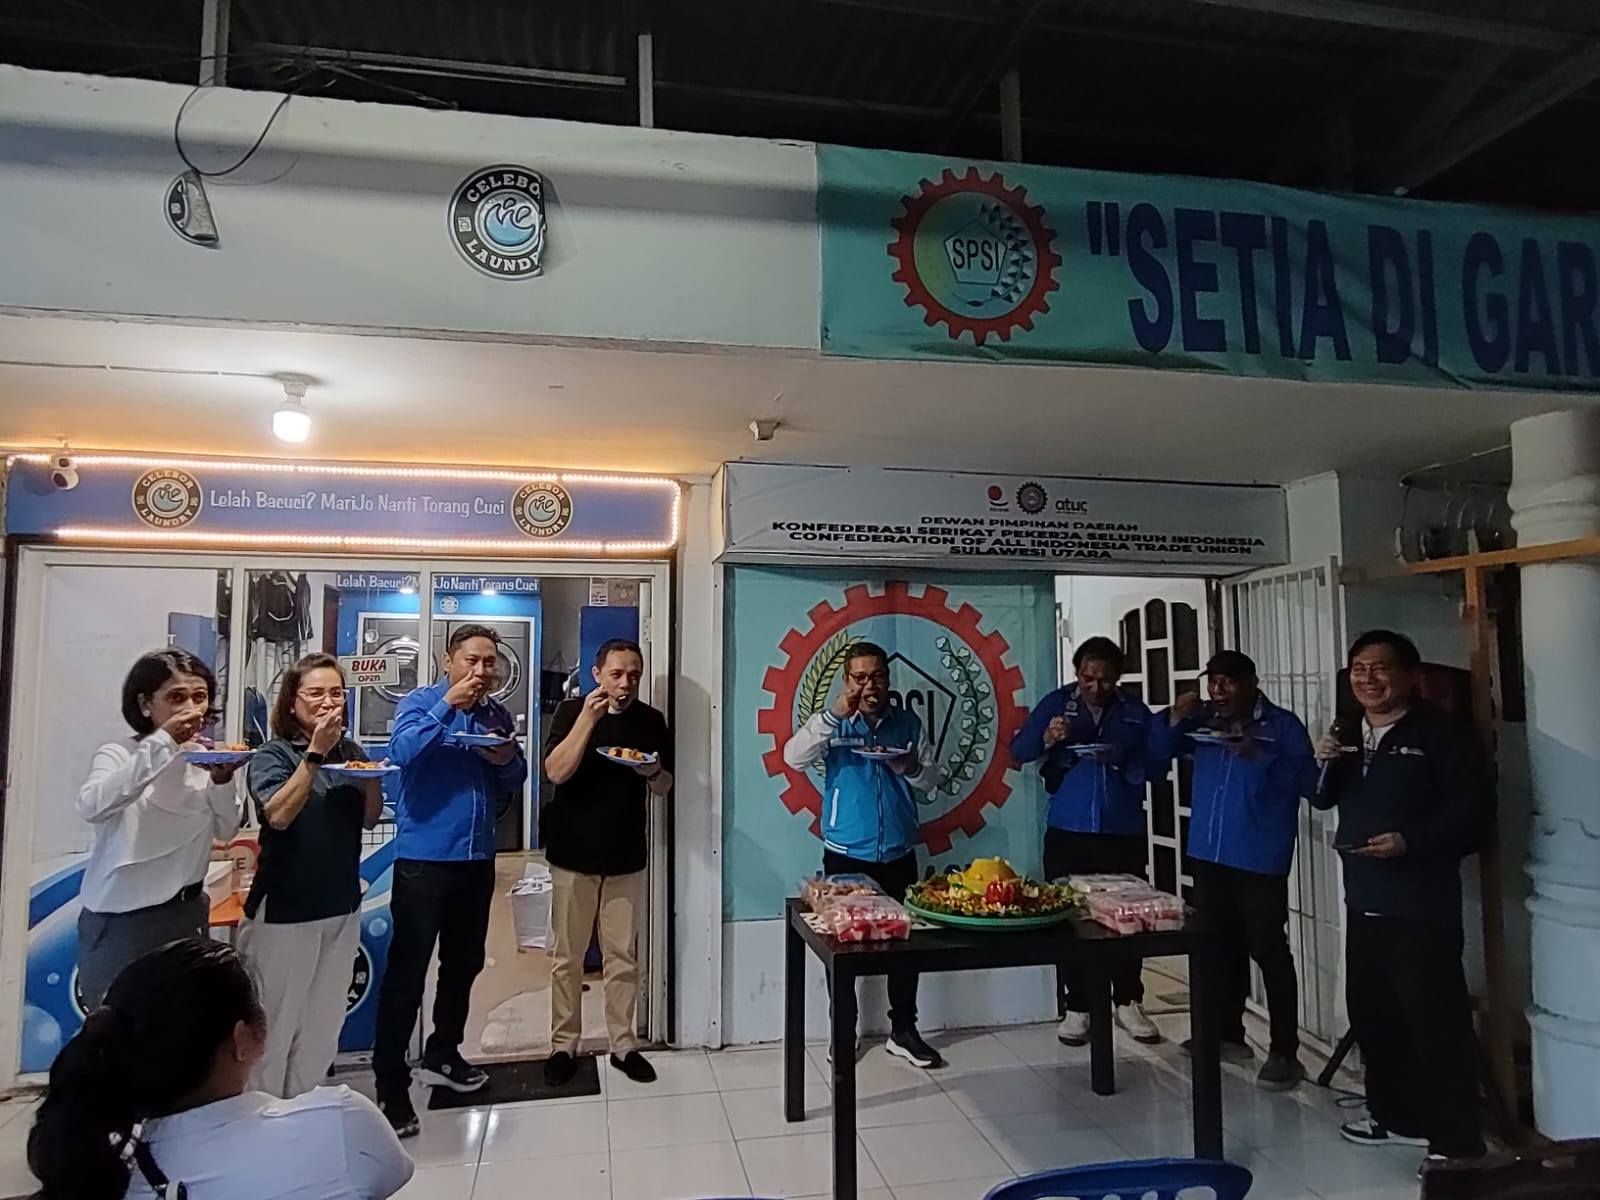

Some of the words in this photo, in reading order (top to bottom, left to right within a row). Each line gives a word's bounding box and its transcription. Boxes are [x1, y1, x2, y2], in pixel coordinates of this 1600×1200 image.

[466, 174, 541, 202] CELEBO
[952, 238, 999, 272] SPSI
[1086, 200, 1352, 362] "SETIA
[1368, 224, 1439, 367] DI
[142, 470, 194, 489] CELEBOR
[519, 483, 566, 501] CELEBOR
[210, 489, 250, 508] Lelah
[256, 491, 316, 510] Bacuci?
[378, 495, 417, 512] Nanti
[422, 497, 470, 518] Torang
[474, 497, 505, 515] Cuci
[1055, 498, 1088, 512] atuc
[141, 508, 193, 527] LAUNDRY
[519, 518, 565, 536] LAUNDRY
[920, 516, 985, 526] DEWAN
[989, 519, 1069, 529] PIMPINAN
[1073, 521, 1138, 532] DAERAH
[772, 521, 912, 535] KONFEDERASI
[917, 527, 997, 538] SERIKAT
[1001, 530, 1083, 540] PEKERJA
[1087, 532, 1167, 543] SELURUH
[1171, 535, 1266, 547] INDONESIA
[789, 532, 956, 545] CONFEDERATION
[960, 536, 987, 546] OF
[991, 538, 1026, 547] ALL
[1031, 539, 1130, 551] INDONESIA
[1134, 543, 1193, 553] TRADE
[1196, 545, 1252, 555] UNION
[950, 545, 1046, 558] SULAWESI
[1051, 548, 1112, 559] UTARA
[450, 576, 478, 591] Nanti
[515, 577, 538, 591] Cuci
[351, 659, 387, 672] BUKA
